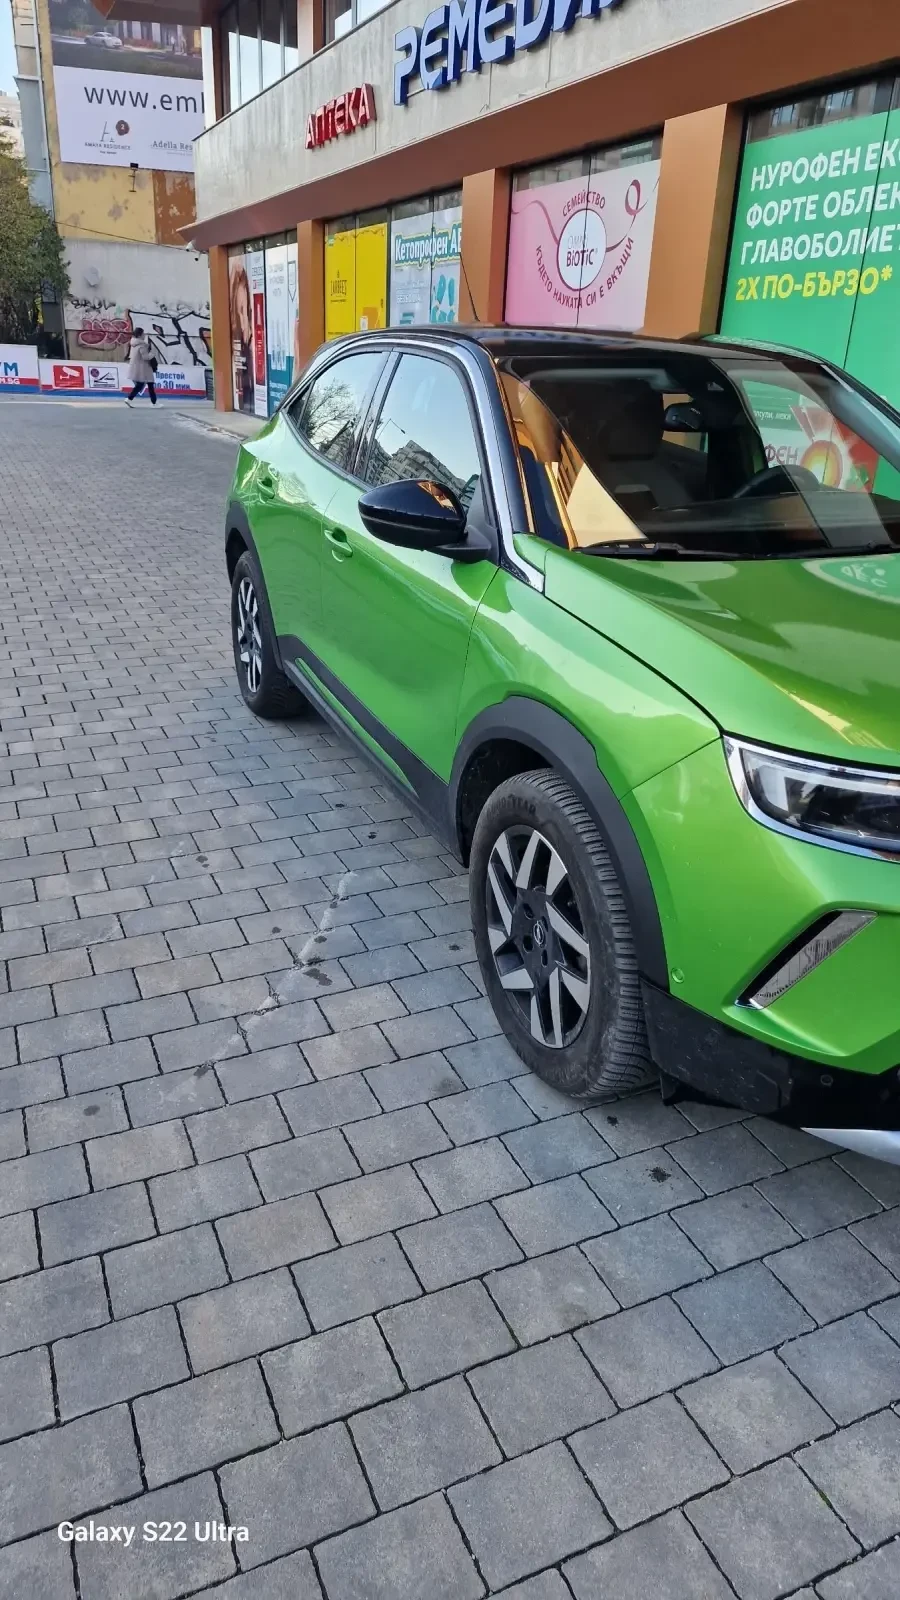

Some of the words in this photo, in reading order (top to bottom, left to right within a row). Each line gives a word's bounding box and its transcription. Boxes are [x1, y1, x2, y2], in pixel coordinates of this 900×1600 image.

[305, 83, 377, 149] АПТЕКА
[152, 141, 177, 149] Adella
[751, 146, 861, 192] НУРОФЕН
[864, 138, 900, 171] ЕК
[562, 189, 606, 217] СЕМЕЙСТВО
[746, 194, 819, 229] ФОРТЕ
[395, 232, 448, 264] Кетопрофен
[536, 245, 553, 293] КЪДЕТО
[553, 287, 583, 309] НАУКАТА
[586, 291, 597, 307] СИ
[599, 285, 605, 299] Е
[606, 236, 634, 291] ВКЪЩИ
[156, 371, 185, 381] Простой
[163, 380, 174, 390] 30
